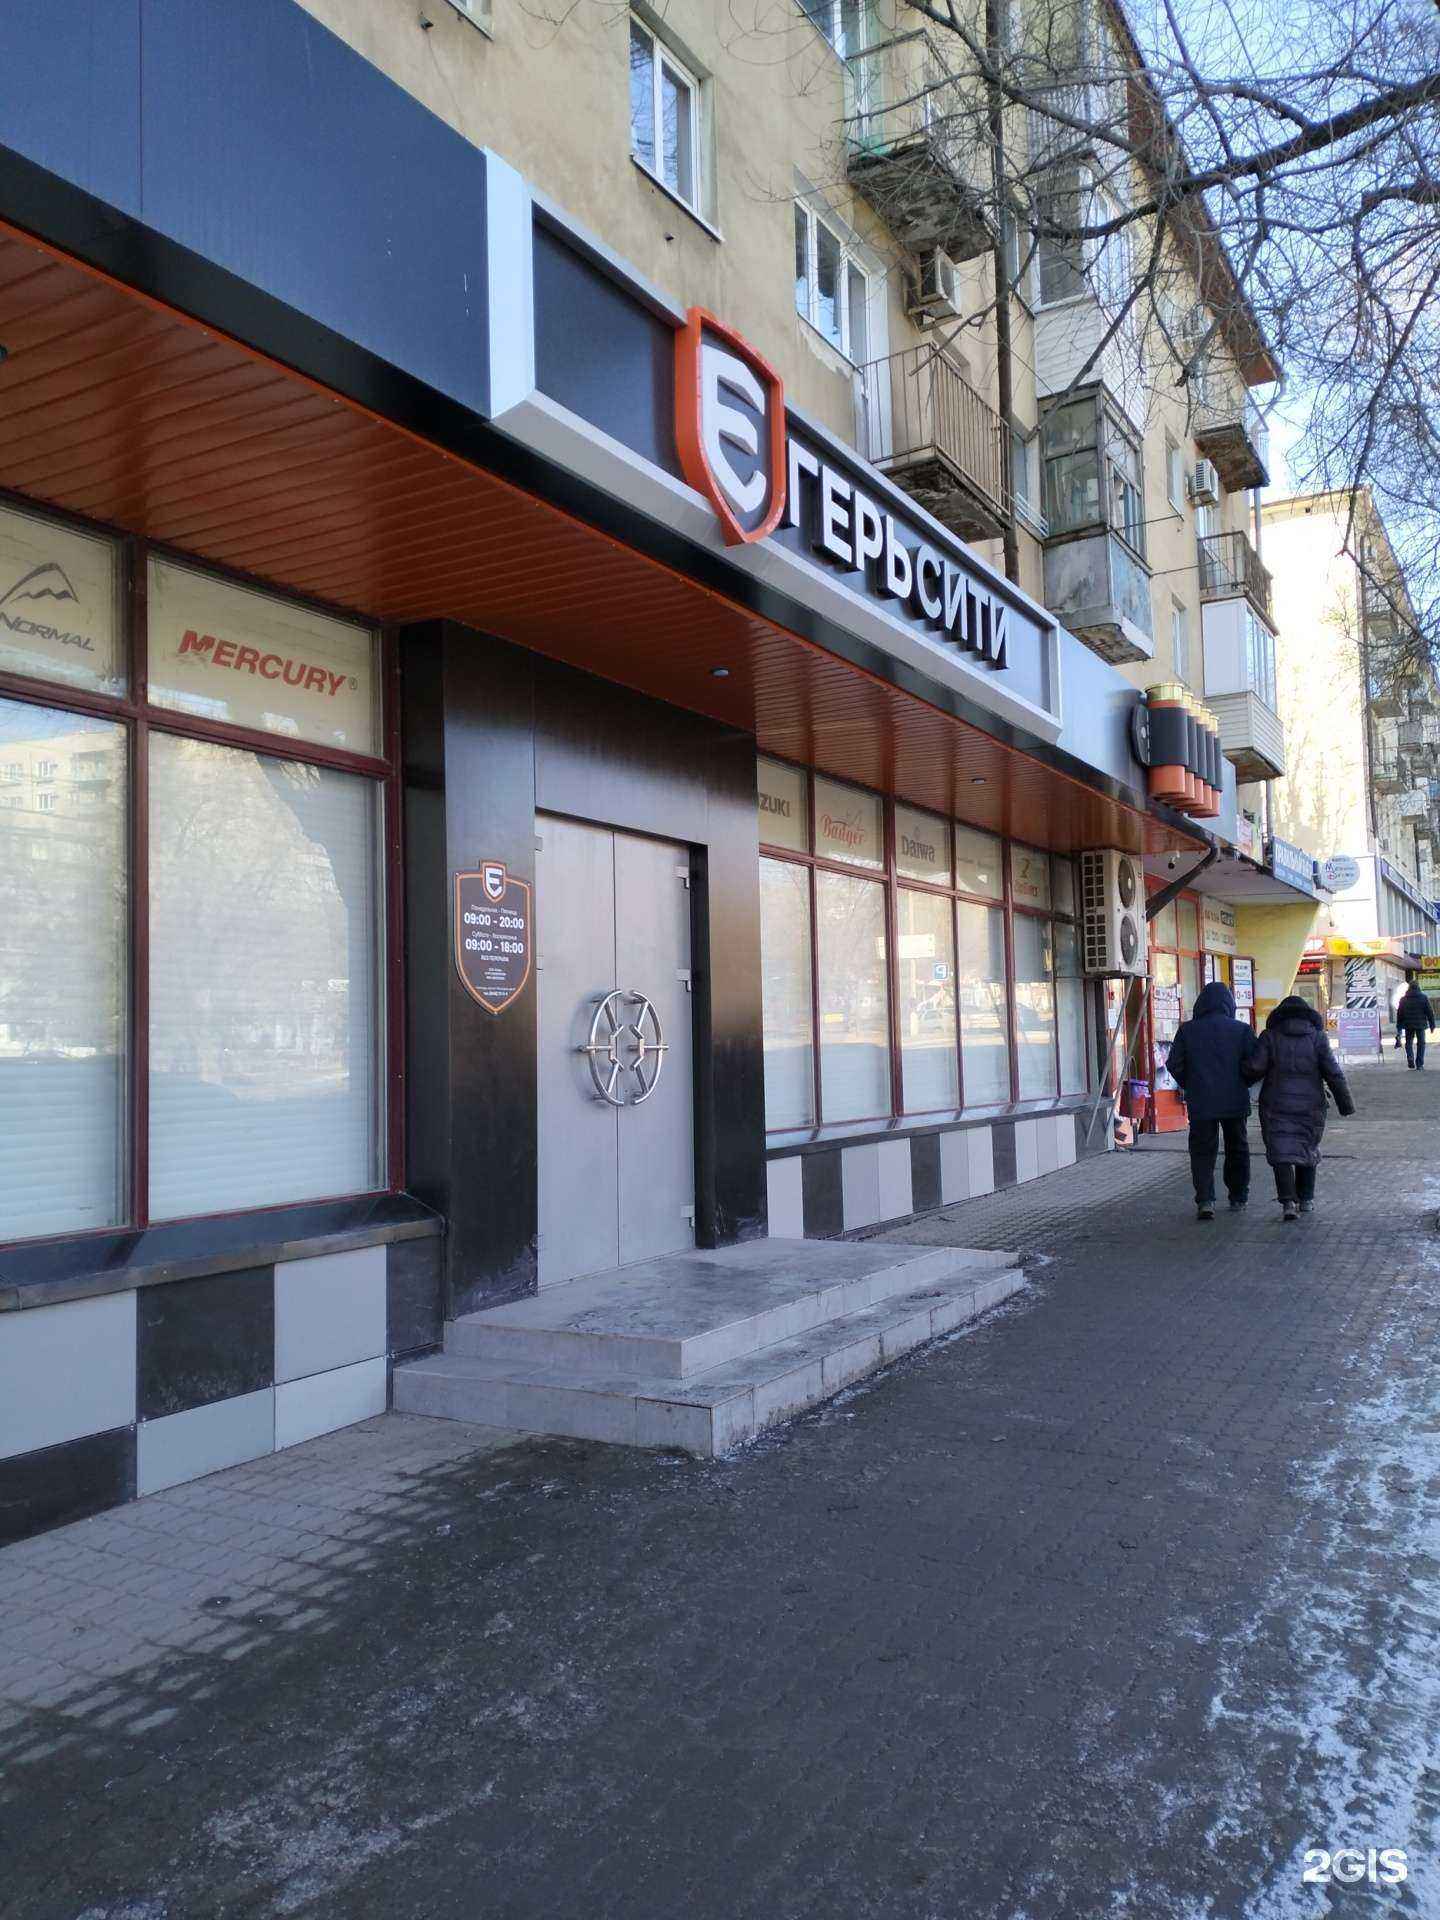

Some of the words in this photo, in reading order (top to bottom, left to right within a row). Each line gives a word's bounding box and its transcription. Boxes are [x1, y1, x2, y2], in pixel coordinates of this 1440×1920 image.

[178, 630, 346, 696] MERCURY
[464, 912, 491, 926] 09:00
[499, 916, 524, 930] 20:00
[465, 939, 492, 952] 09:00
